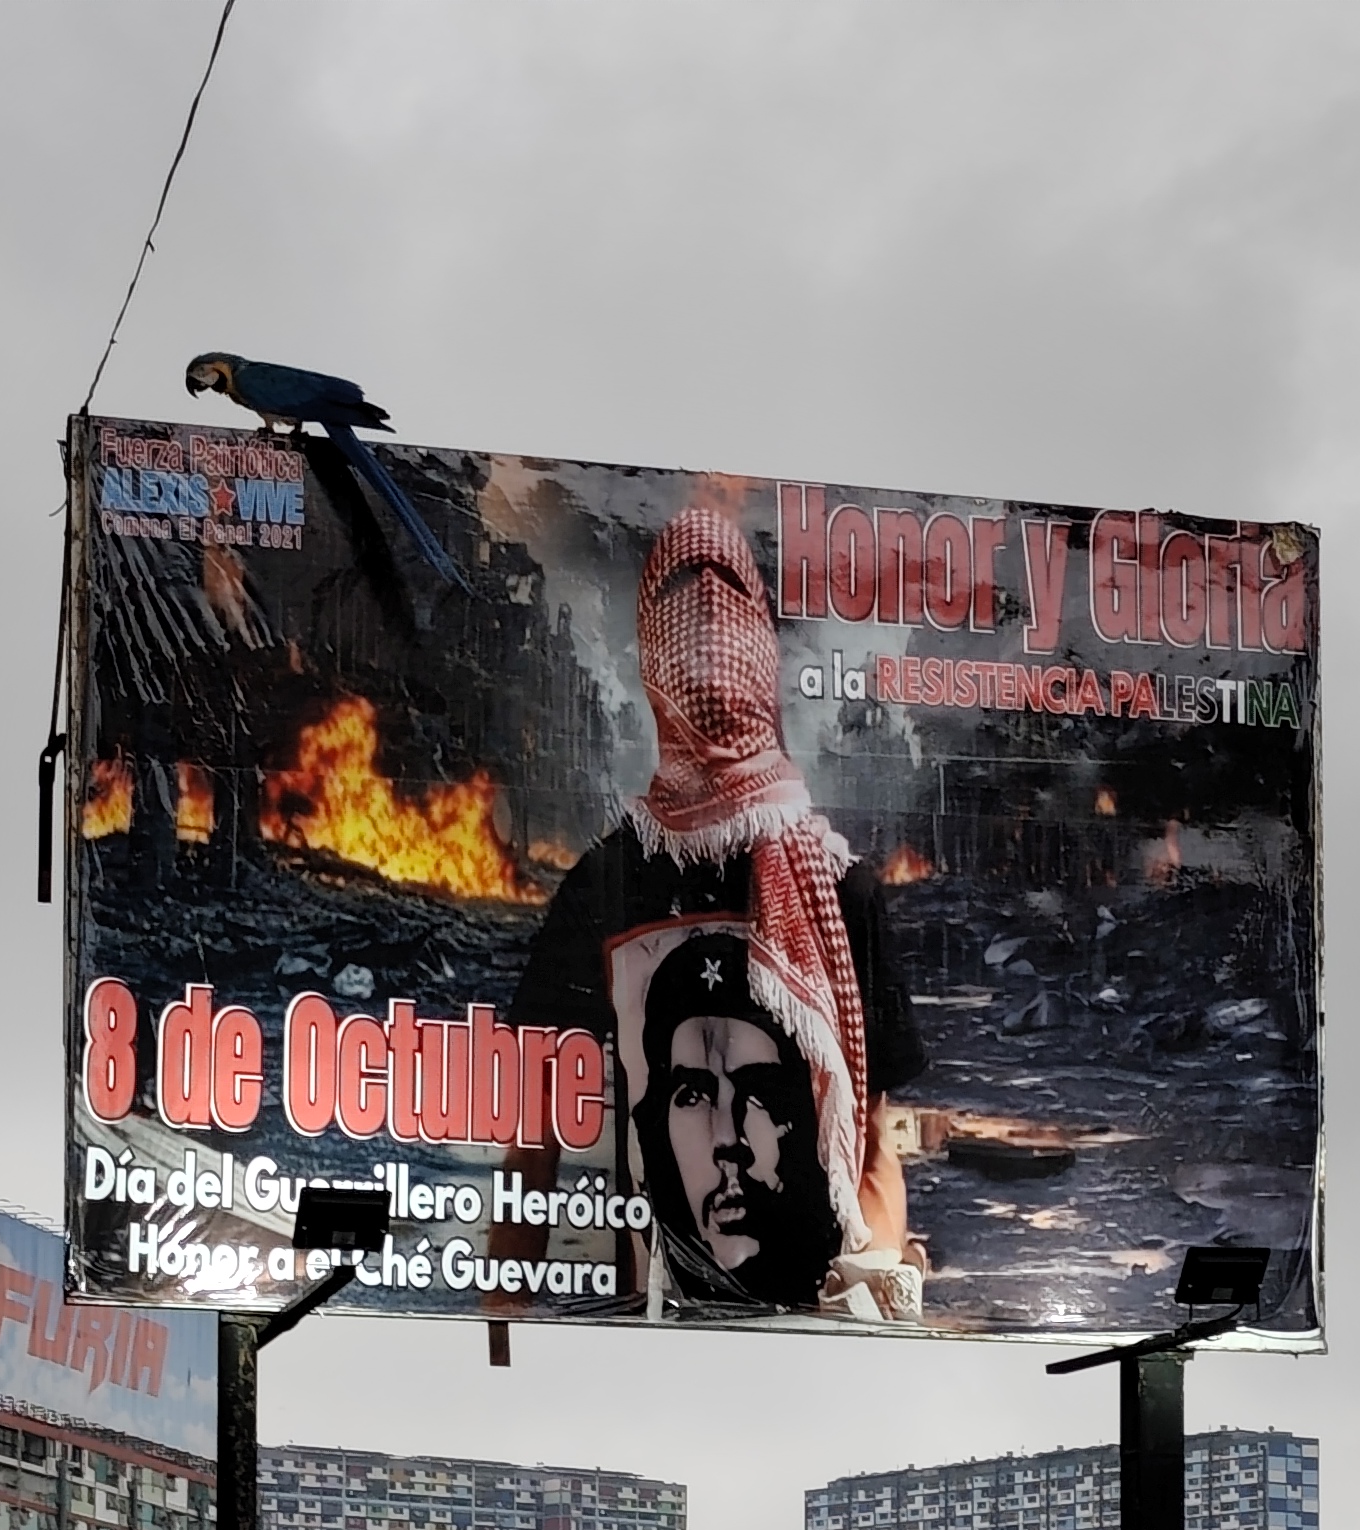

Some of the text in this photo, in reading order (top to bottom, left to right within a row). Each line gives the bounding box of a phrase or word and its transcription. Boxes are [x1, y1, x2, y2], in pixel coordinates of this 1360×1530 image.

[100, 427, 184, 472] Fuerza
[101, 467, 305, 525] ALEXIS VIVE
[101, 511, 171, 539] Comuna
[179, 516, 195, 541] El
[259, 523, 302, 550] 2021
[777, 480, 1307, 656] Honor y Gloria
[798, 650, 1302, 730] a la RESISTENCIA PALESTINA
[84, 976, 605, 1152] 8 de Octubre
[84, 1145, 652, 1230] Día del Guillero Heróico
[267, 1247, 295, 1281] a
[442, 1236, 617, 1295] Guevara
